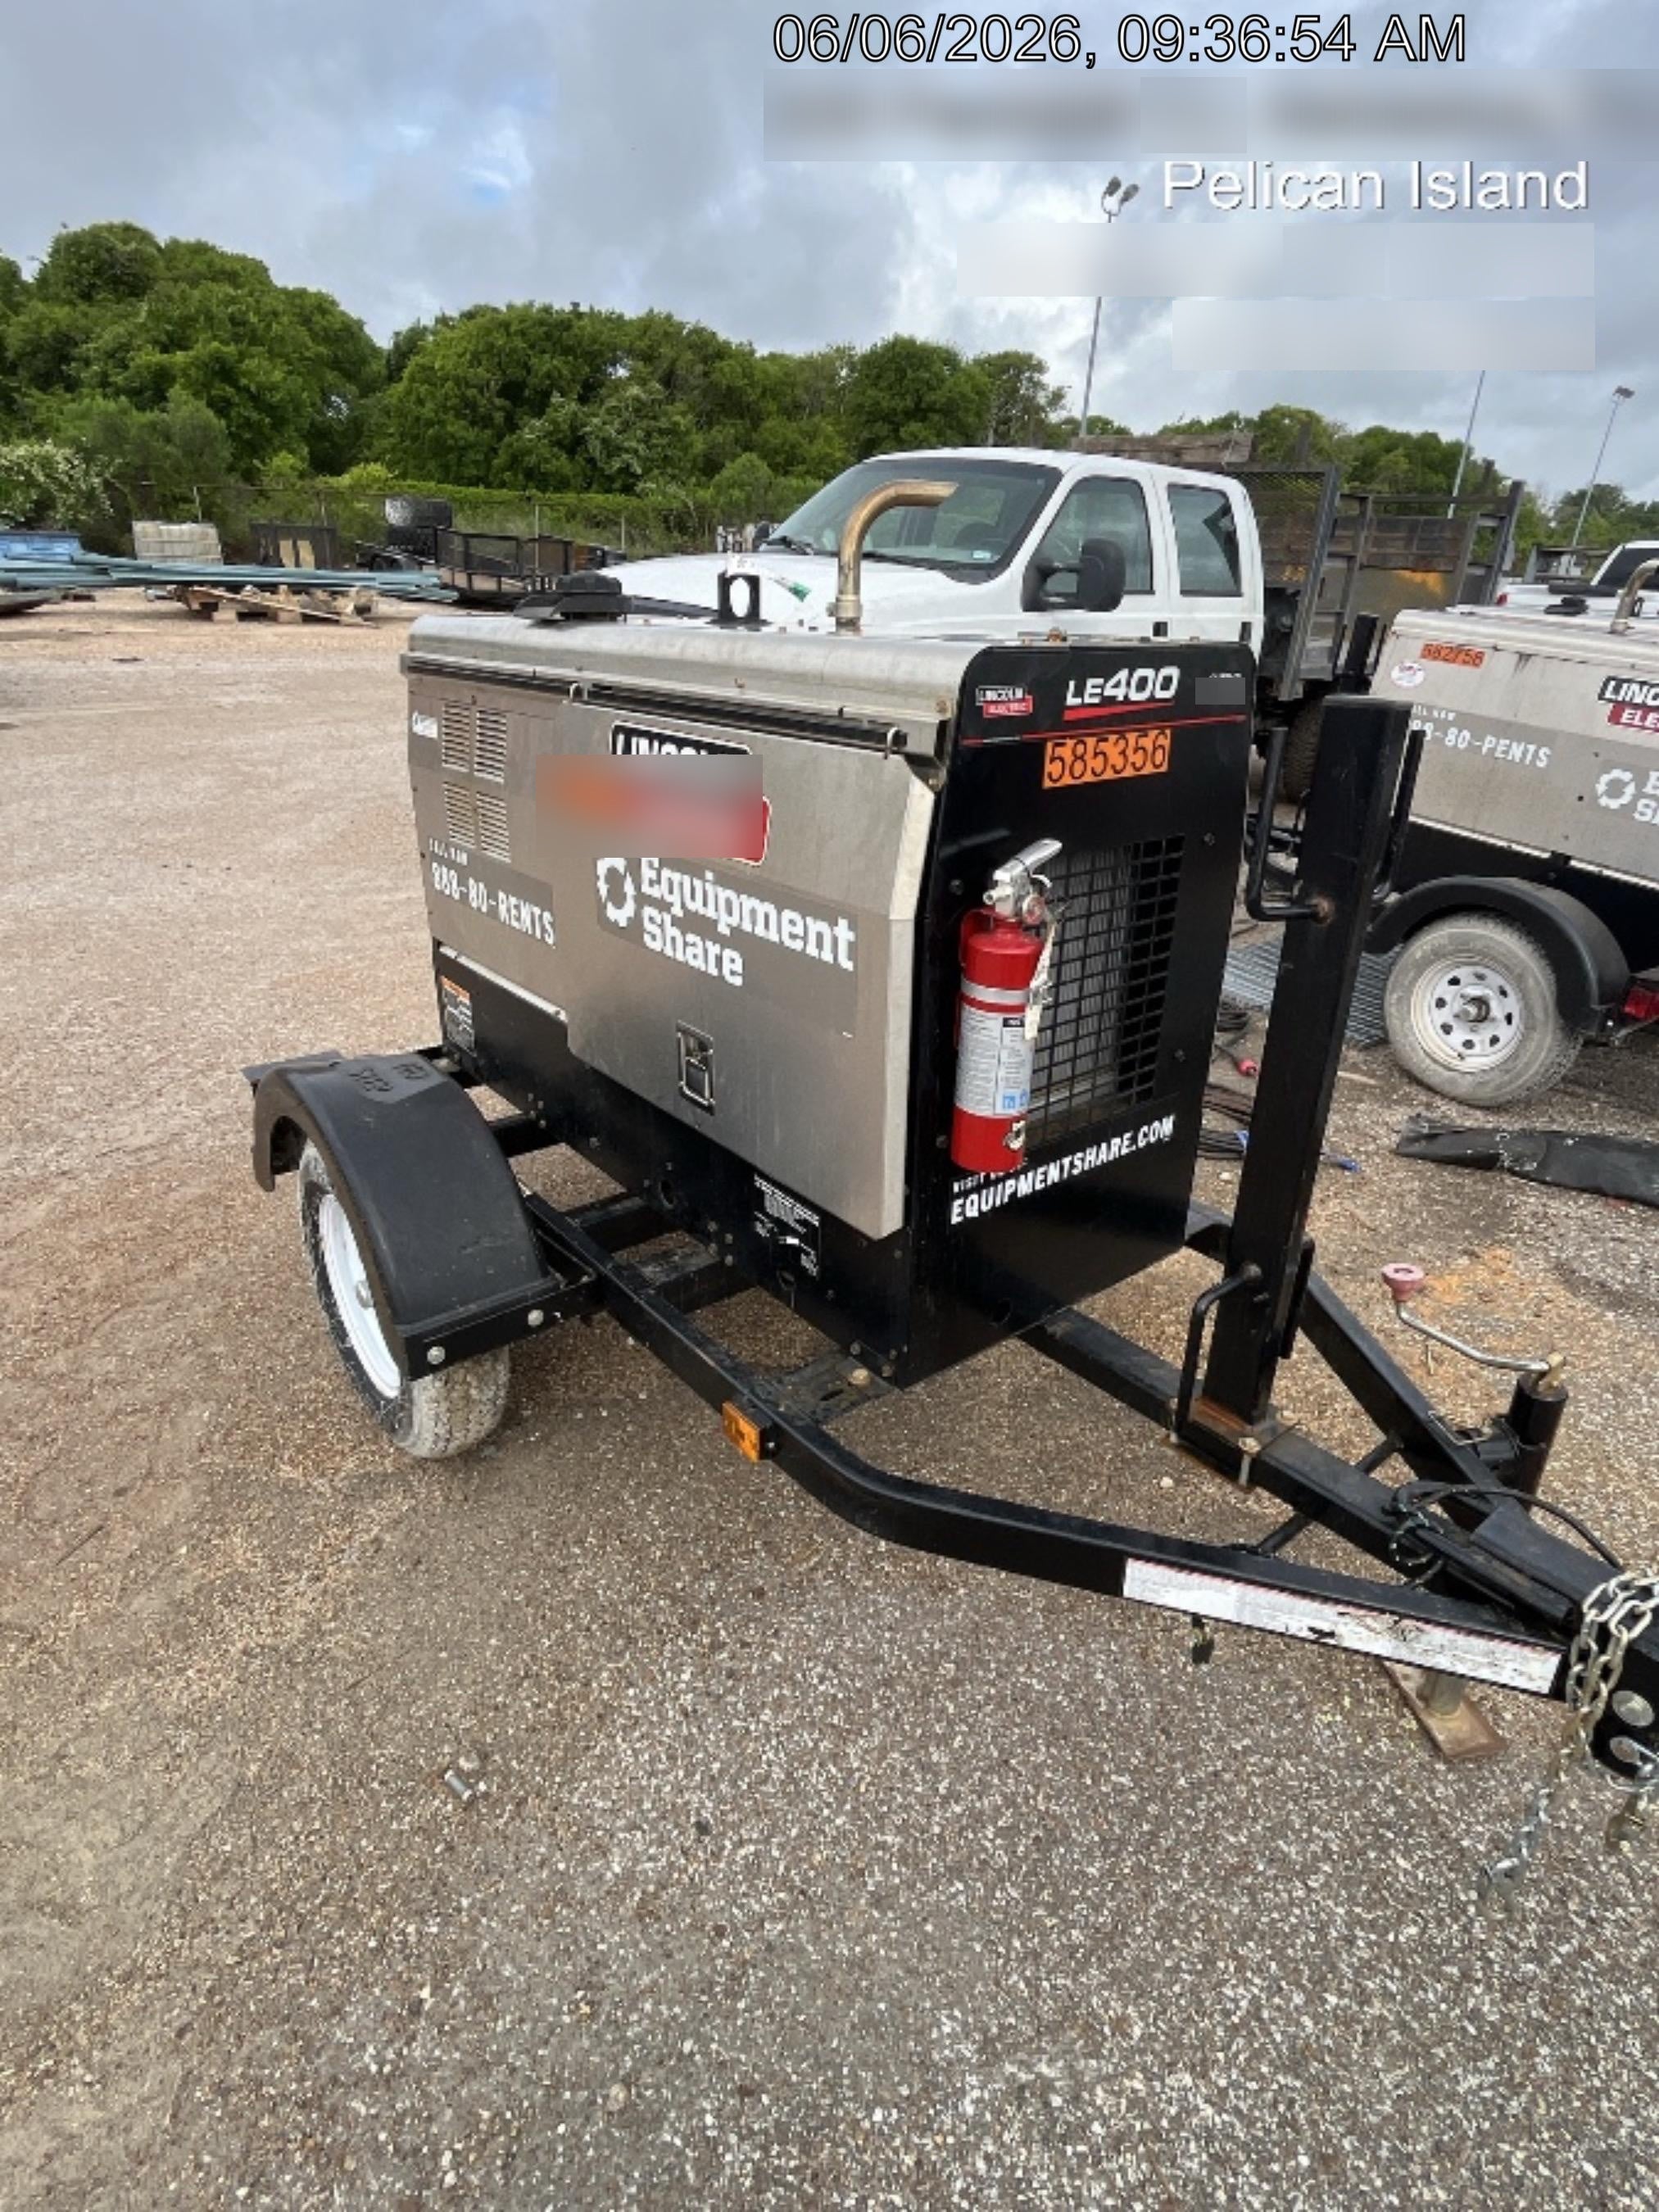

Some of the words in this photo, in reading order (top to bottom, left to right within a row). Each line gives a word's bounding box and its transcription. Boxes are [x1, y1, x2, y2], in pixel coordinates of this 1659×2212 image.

[1067, 665, 1181, 706] LE400
[1047, 732, 1168, 784] 585356
[641, 858, 855, 972] Equipment
[642, 905, 743, 986] Share
[950, 1113, 1176, 1225] EQUIPMENTSHARE.COM
